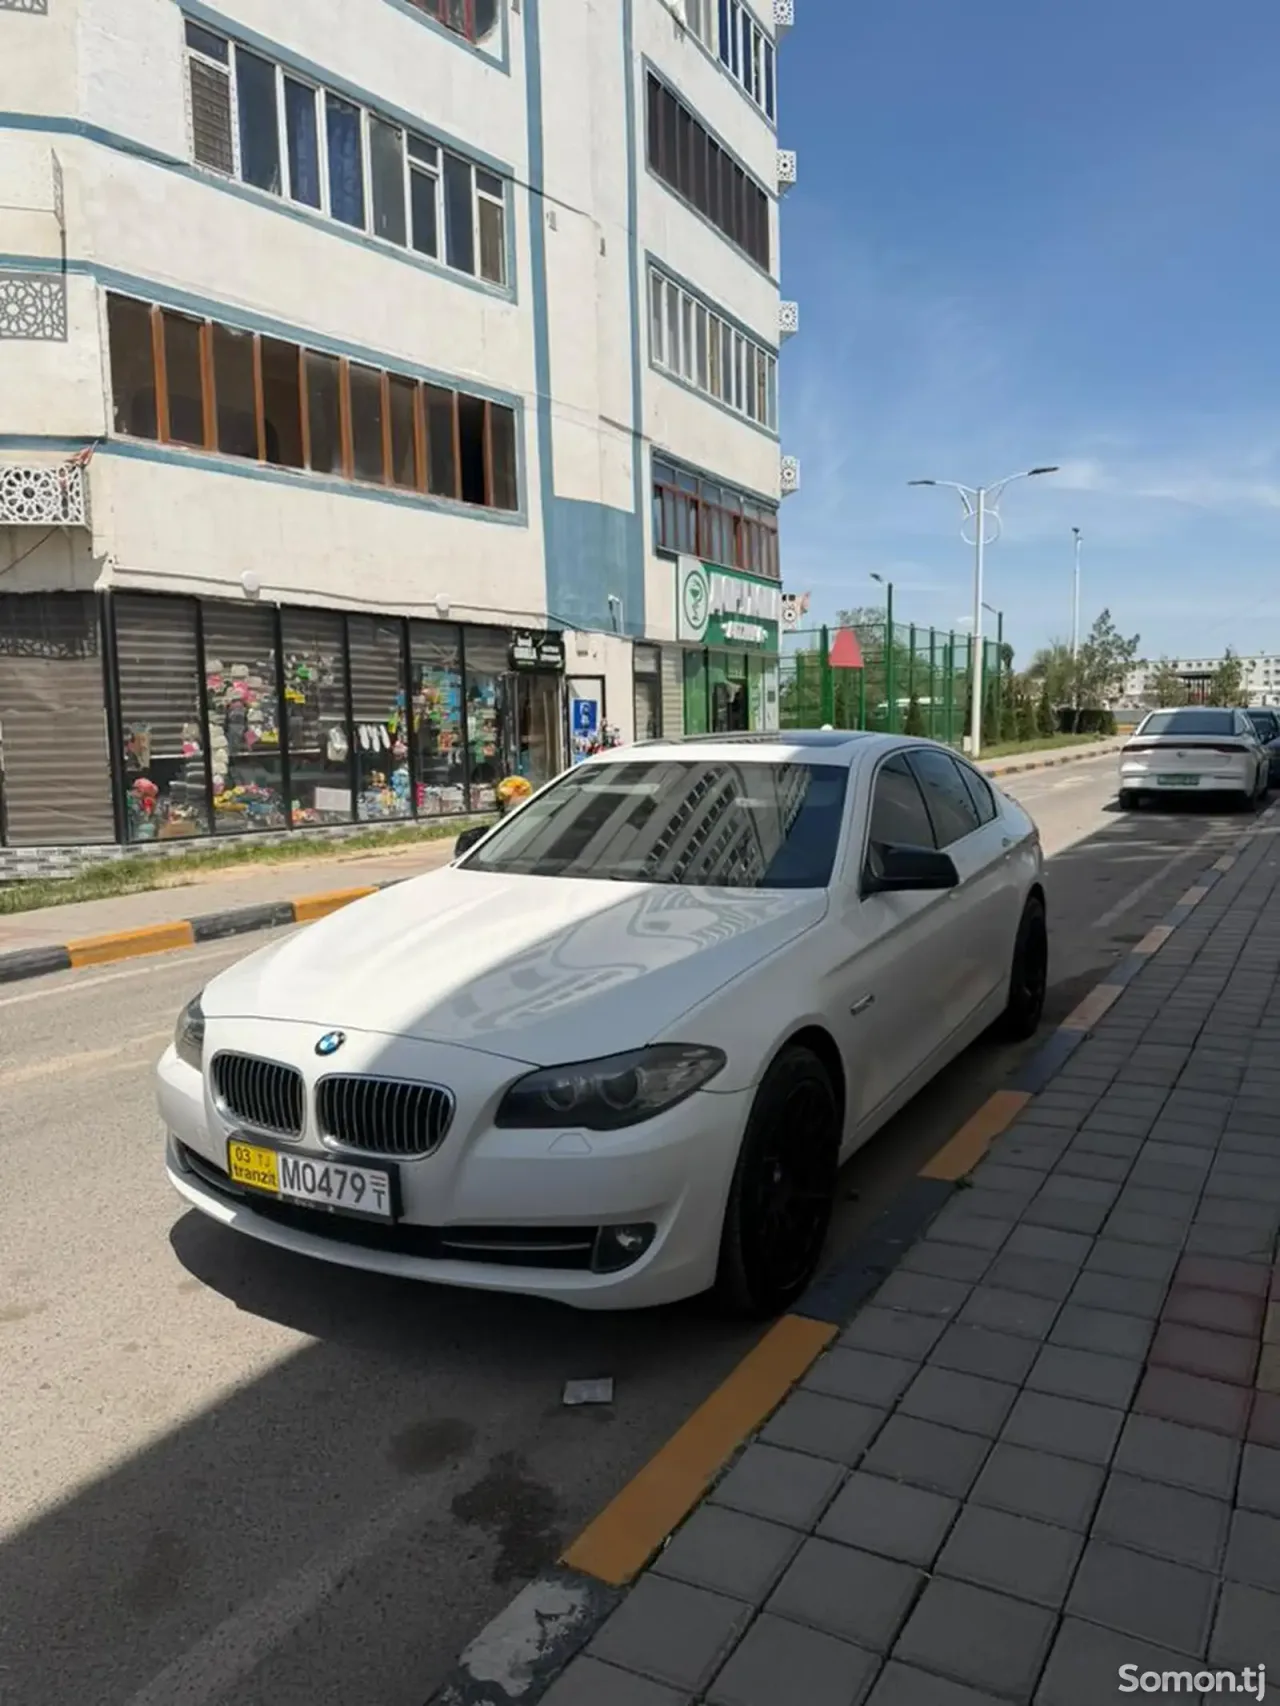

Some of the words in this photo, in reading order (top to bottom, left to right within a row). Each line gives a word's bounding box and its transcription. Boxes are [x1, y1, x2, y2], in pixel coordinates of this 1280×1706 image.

[235, 1146, 252, 1164] 03
[233, 1163, 277, 1188] tranzit
[281, 1157, 367, 1204] M0479
[372, 1187, 387, 1210] T
